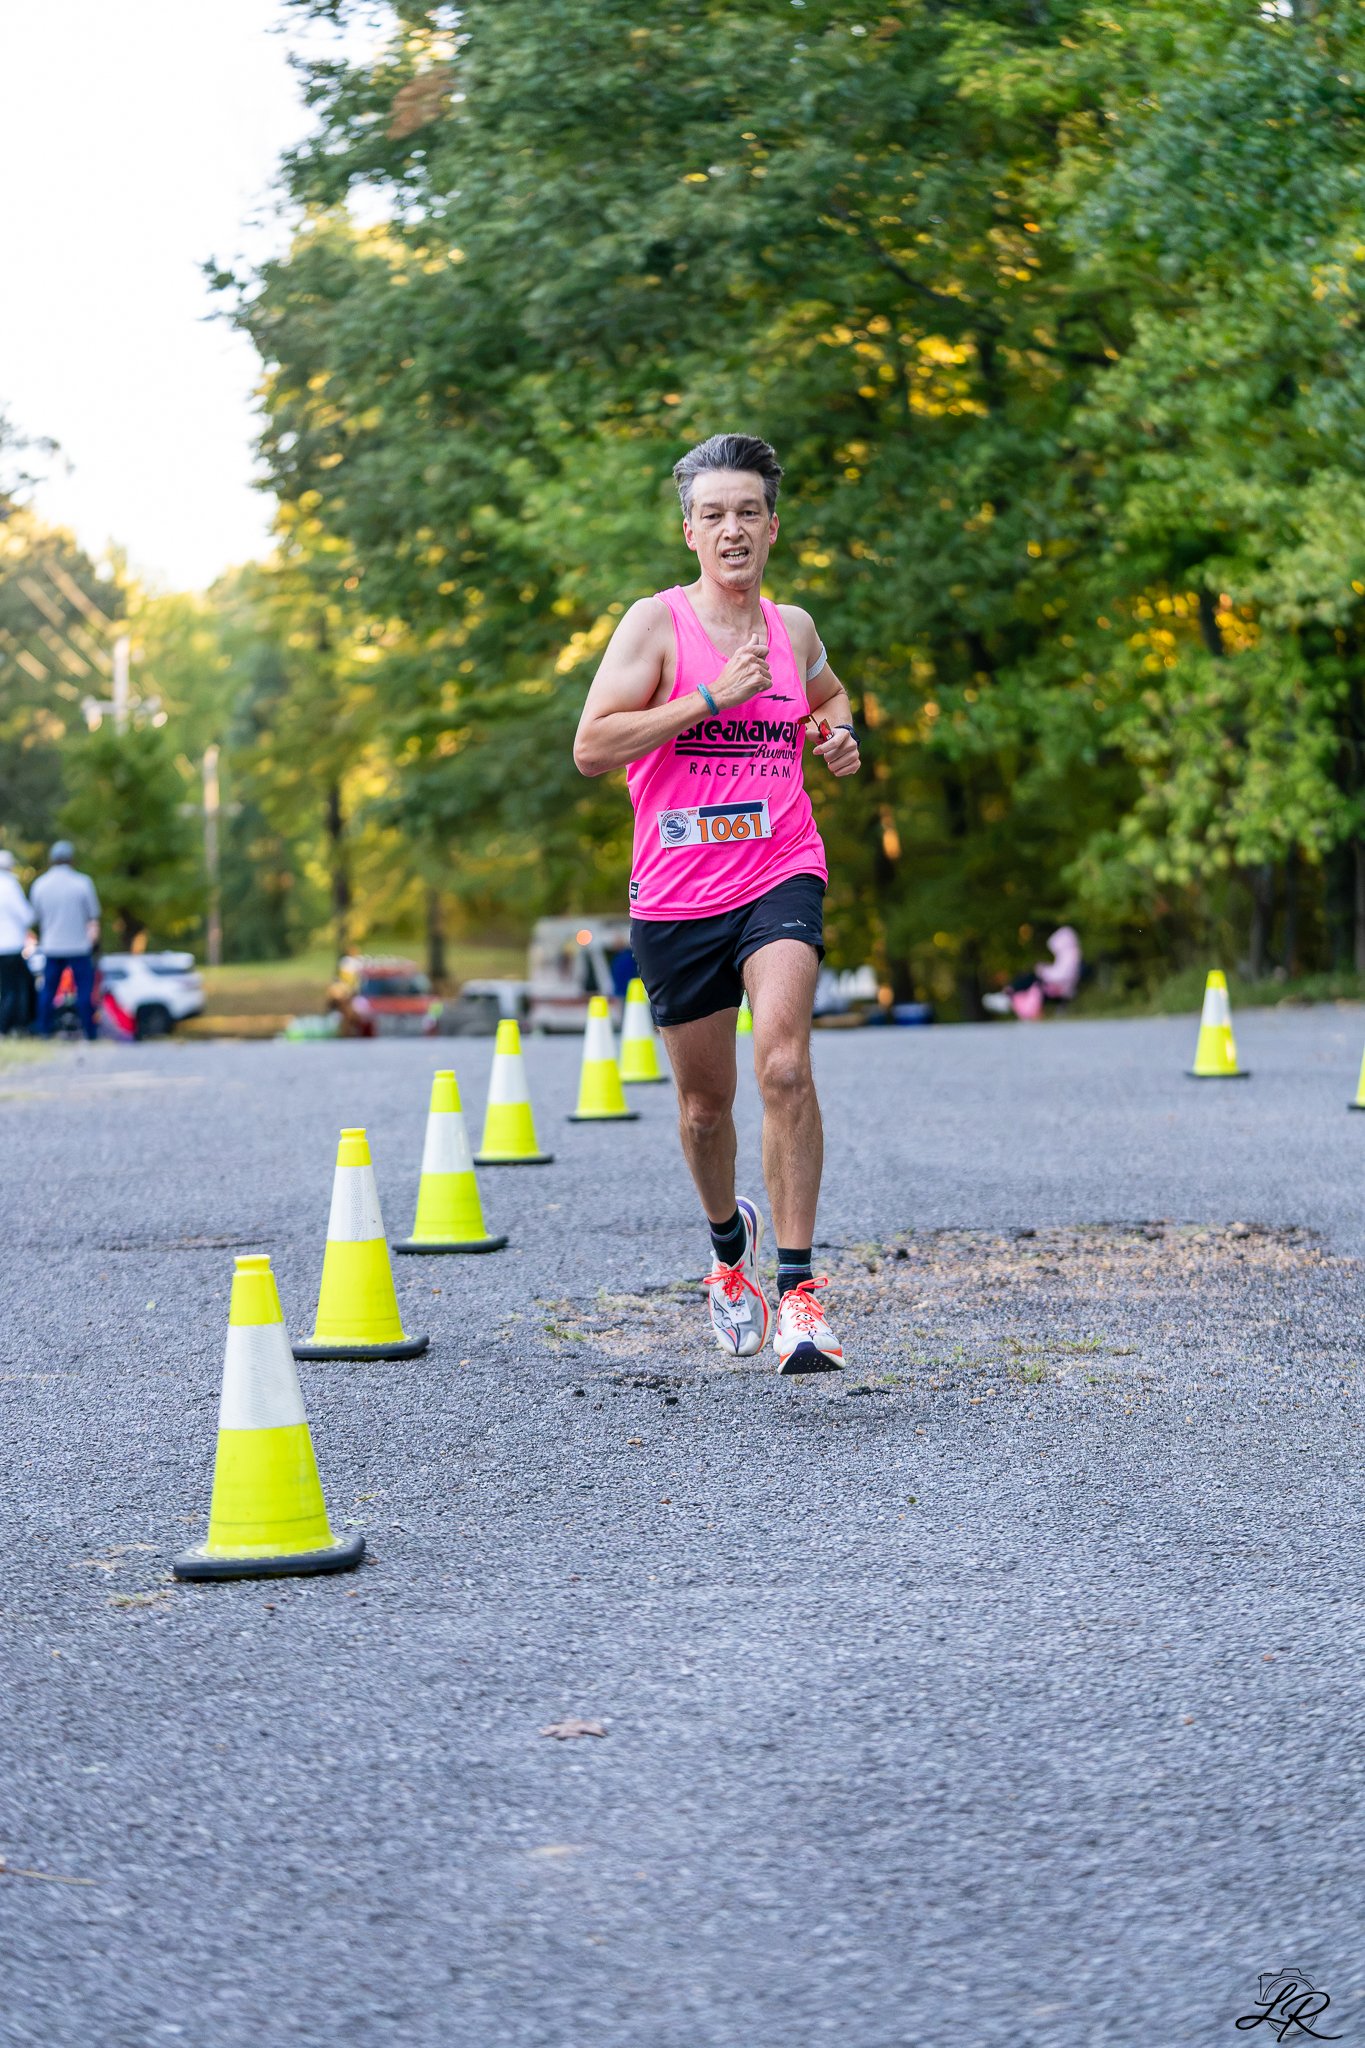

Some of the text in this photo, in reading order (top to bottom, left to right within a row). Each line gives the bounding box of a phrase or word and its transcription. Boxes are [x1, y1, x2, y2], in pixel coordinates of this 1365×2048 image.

[755, 744, 797, 764] Running
[690, 762, 791, 778] RACE TEAM
[697, 814, 762, 842] 1061
